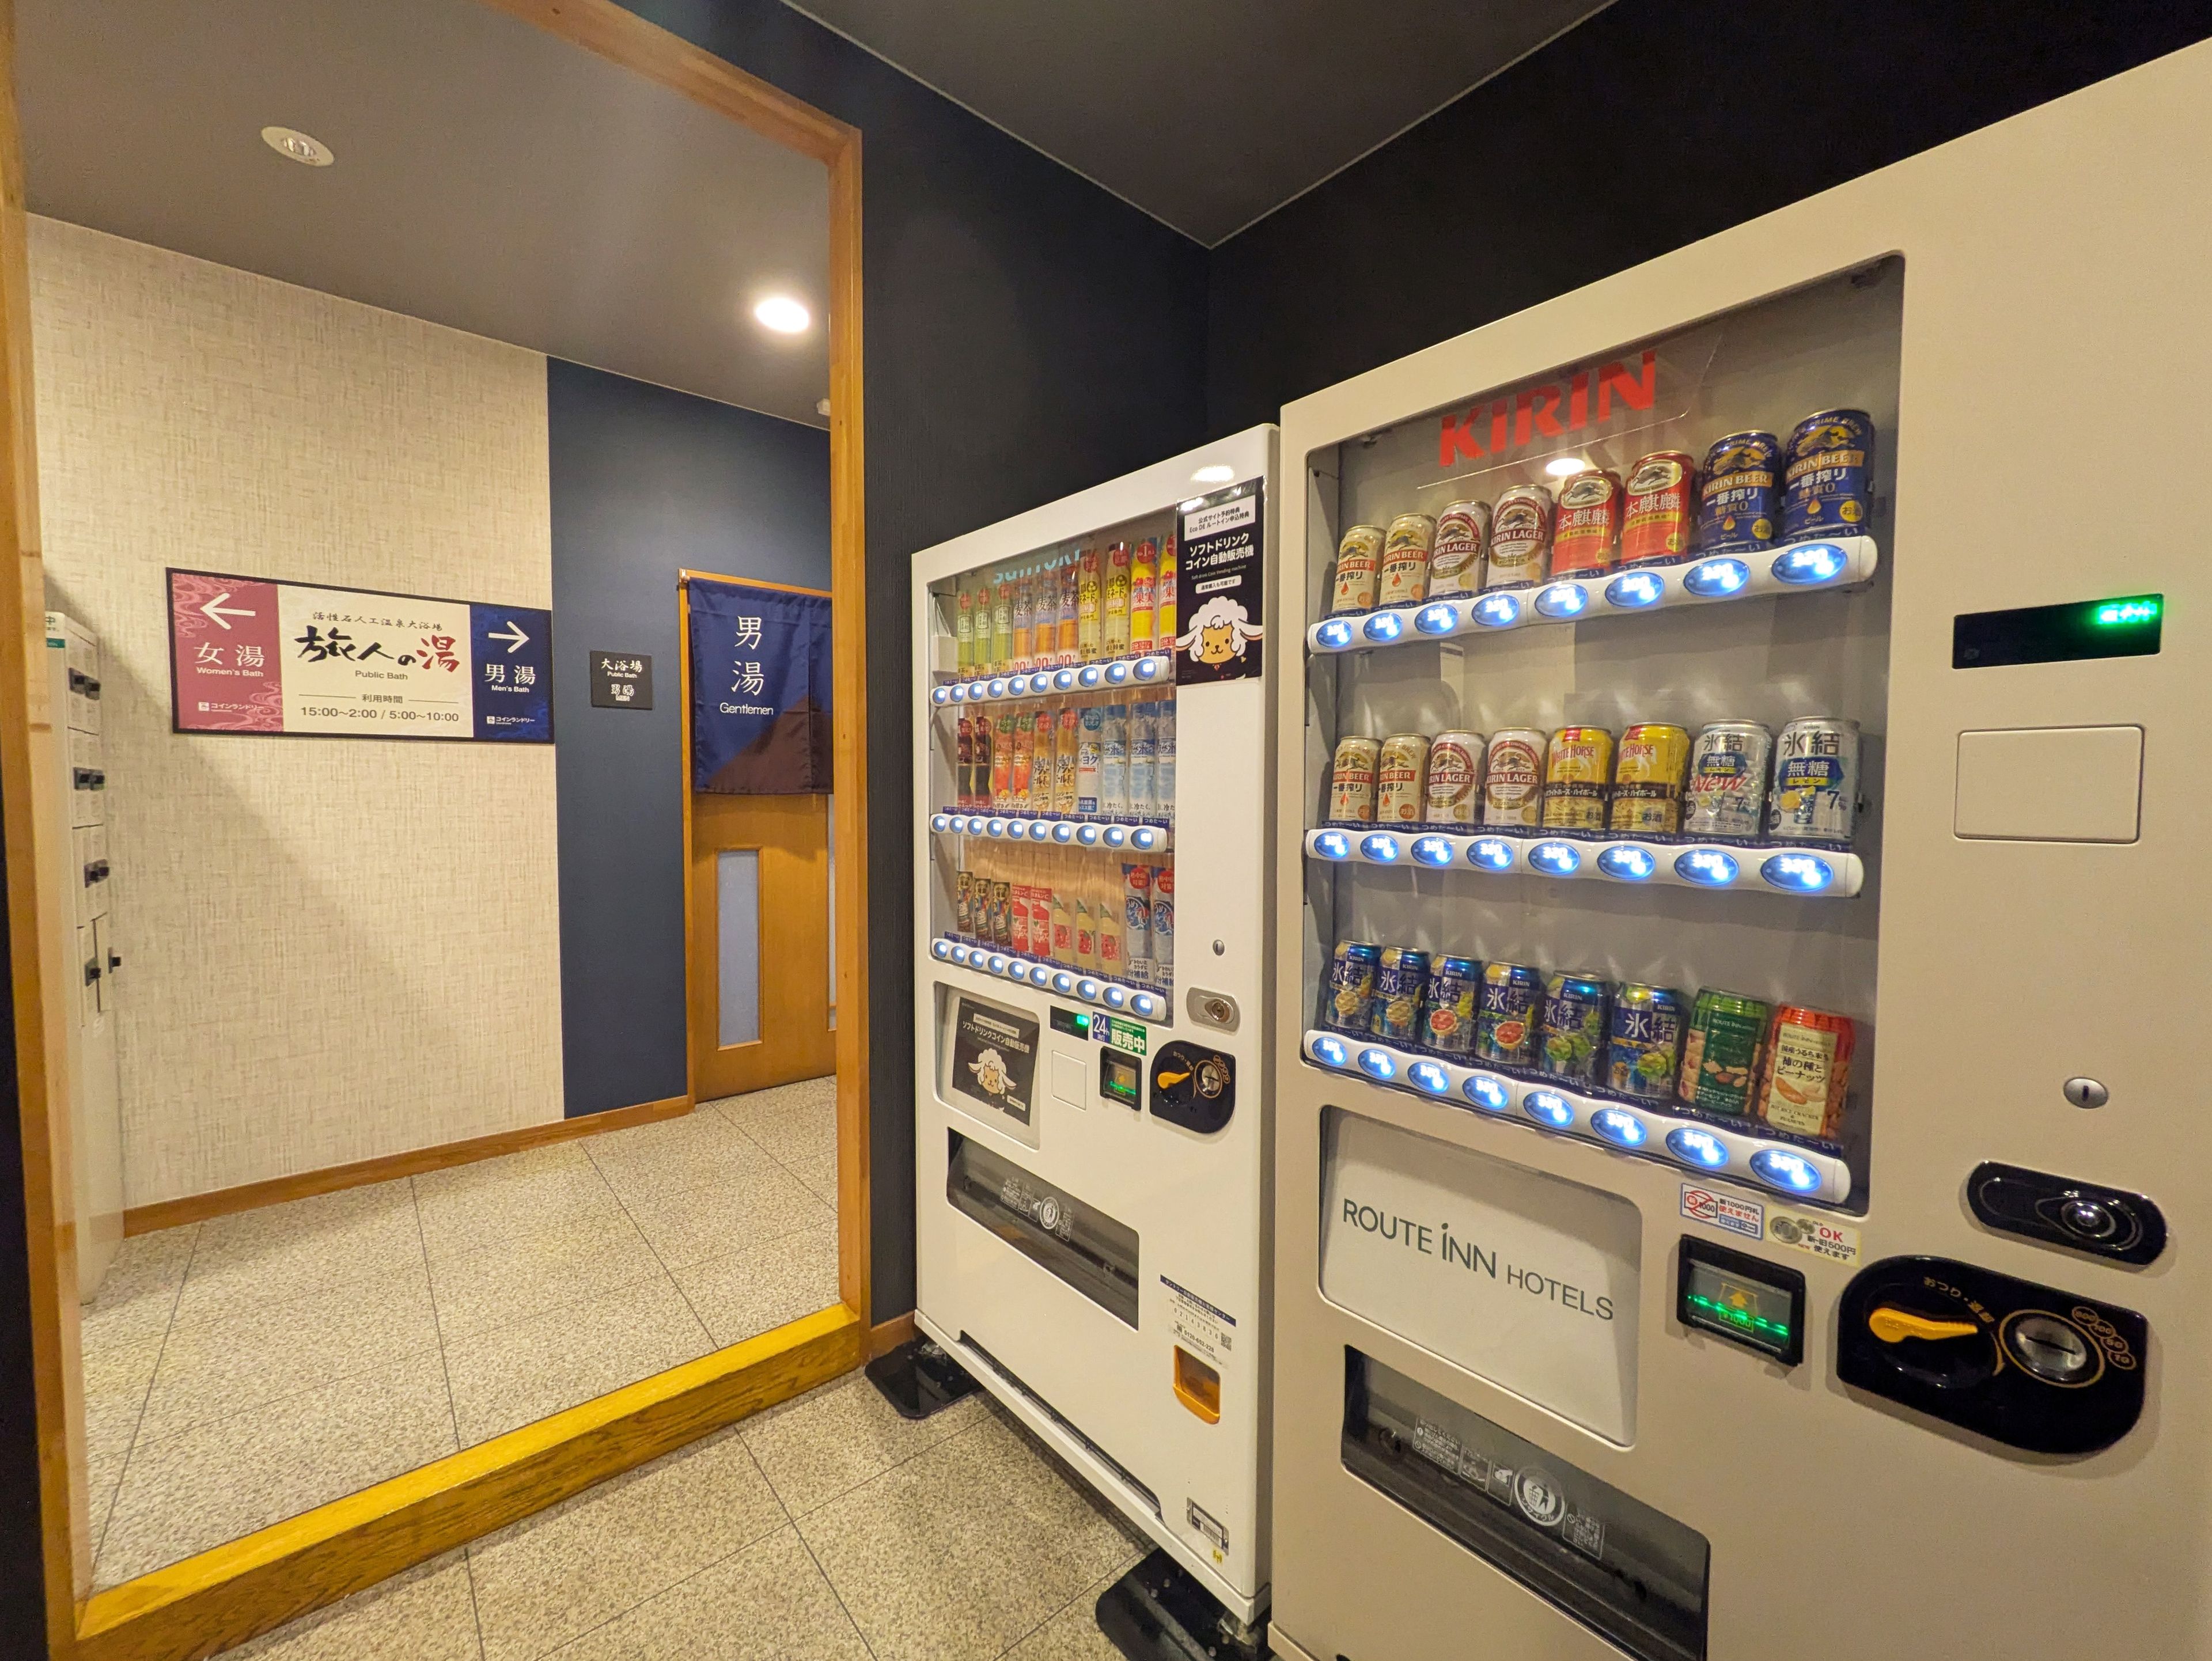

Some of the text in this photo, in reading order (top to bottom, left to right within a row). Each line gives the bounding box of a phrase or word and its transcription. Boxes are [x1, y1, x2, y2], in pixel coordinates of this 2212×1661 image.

[1440, 350, 1657, 468] KIRIN
[1736, 473, 1768, 485] BEER
[1789, 468, 1847, 490] 一番搾り
[1706, 488, 1758, 506] 一番搾り
[1626, 493, 1681, 518] 本麒麟
[1559, 509, 1610, 530] 本麒麟
[1513, 530, 1544, 540] LAGER
[1190, 532, 1249, 557] ソフトドリンク
[1447, 543, 1477, 552] LAGER
[1185, 544, 1254, 570] コイン自動販売機
[1402, 551, 1423, 559] BEER
[1384, 562, 1416, 573] 一番搾り
[1336, 571, 1362, 582] 一番搾り
[1038, 594, 1056, 611] 麦茶
[313, 612, 442, 631] 活性石人工温泉大浴場
[294, 625, 460, 672] 旅人の湯
[731, 616, 764, 696] 男湯
[196, 666, 263, 677] Women's Bath
[601, 658, 642, 673] 大浴場
[355, 670, 384, 679] Public
[484, 663, 536, 684] 男湯
[362, 694, 403, 703] 利用時間
[720, 702, 774, 715] Gentlemen
[1704, 734, 1744, 752] 氷結
[1783, 731, 1840, 756] 氷結
[1570, 744, 1594, 759] HORSE
[1631, 744, 1654, 758] HORSE
[1707, 755, 1735, 767] 無糖
[1787, 761, 1830, 777] 無糖
[1441, 774, 1471, 783] LAGER
[1508, 774, 1538, 783] LAGER
[1692, 773, 1747, 793] New
[1334, 783, 1362, 792] 一番搾り
[1642, 811, 1662, 823] お酒
[1563, 992, 1582, 1000] KIRIN
[1111, 1029, 1145, 1053] 販売中
[1782, 1056, 1822, 1073] 柿の種と
[1719, 1199, 1759, 1215] 新1000円札
[1719, 1205, 1759, 1222] 使えません
[1819, 1227, 1843, 1242] OK
[1343, 1199, 1432, 1254] ROUTE
[1508, 1264, 1613, 1321] HOTELS
[1813, 1246, 1849, 1260] 使えます
